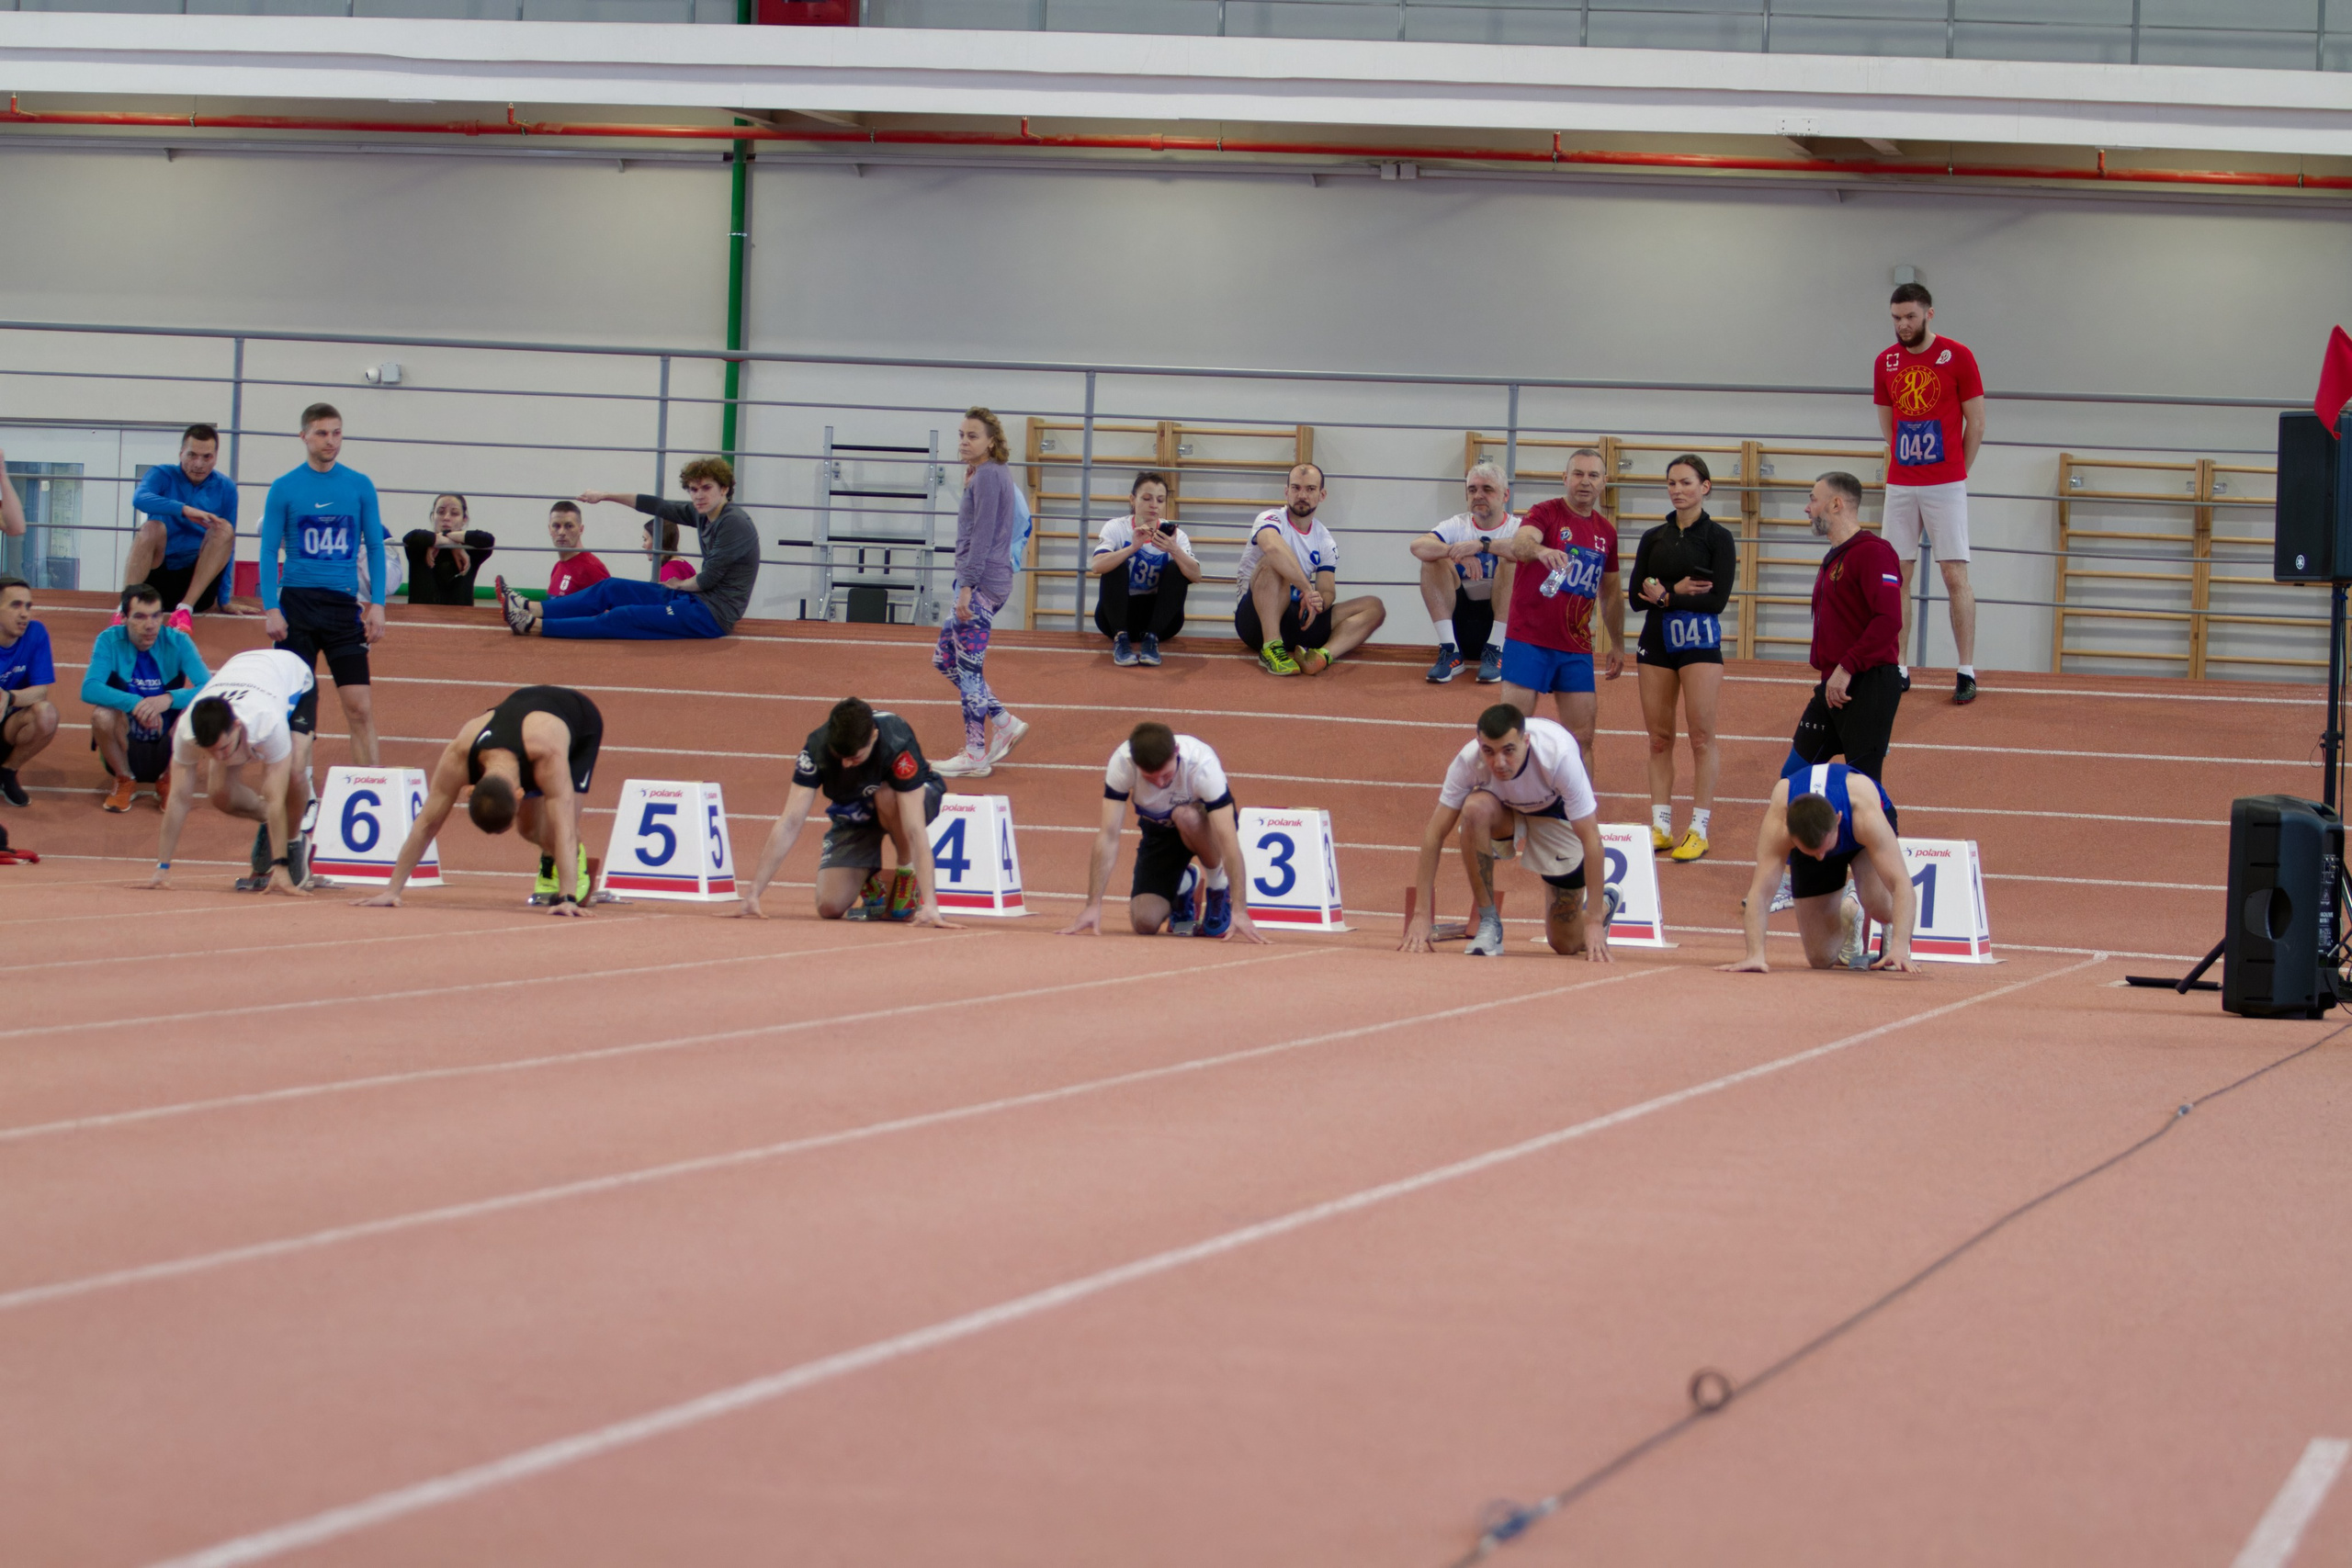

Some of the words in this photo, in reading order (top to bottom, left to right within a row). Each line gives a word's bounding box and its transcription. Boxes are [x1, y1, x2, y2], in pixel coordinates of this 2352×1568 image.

[1899, 433, 1937, 461] 042
[304, 526, 349, 555] 044
[1127, 555, 1161, 586] 135
[1566, 558, 1602, 593] 043
[1670, 616, 1714, 647] 041
[354, 776, 387, 784] polanik
[649, 789, 684, 798] polanik
[341, 789, 381, 852] 6
[942, 804, 976, 812] polanik
[1267, 818, 1303, 827] polanik
[635, 802, 677, 867] 5
[707, 805, 724, 869] 5
[932, 818, 970, 883] 4
[1001, 818, 1013, 883] 4
[1253, 831, 1296, 897] 3
[1324, 832, 1335, 898] 3
[1915, 848, 1951, 858] polanik
[1911, 863, 1937, 929] 1
